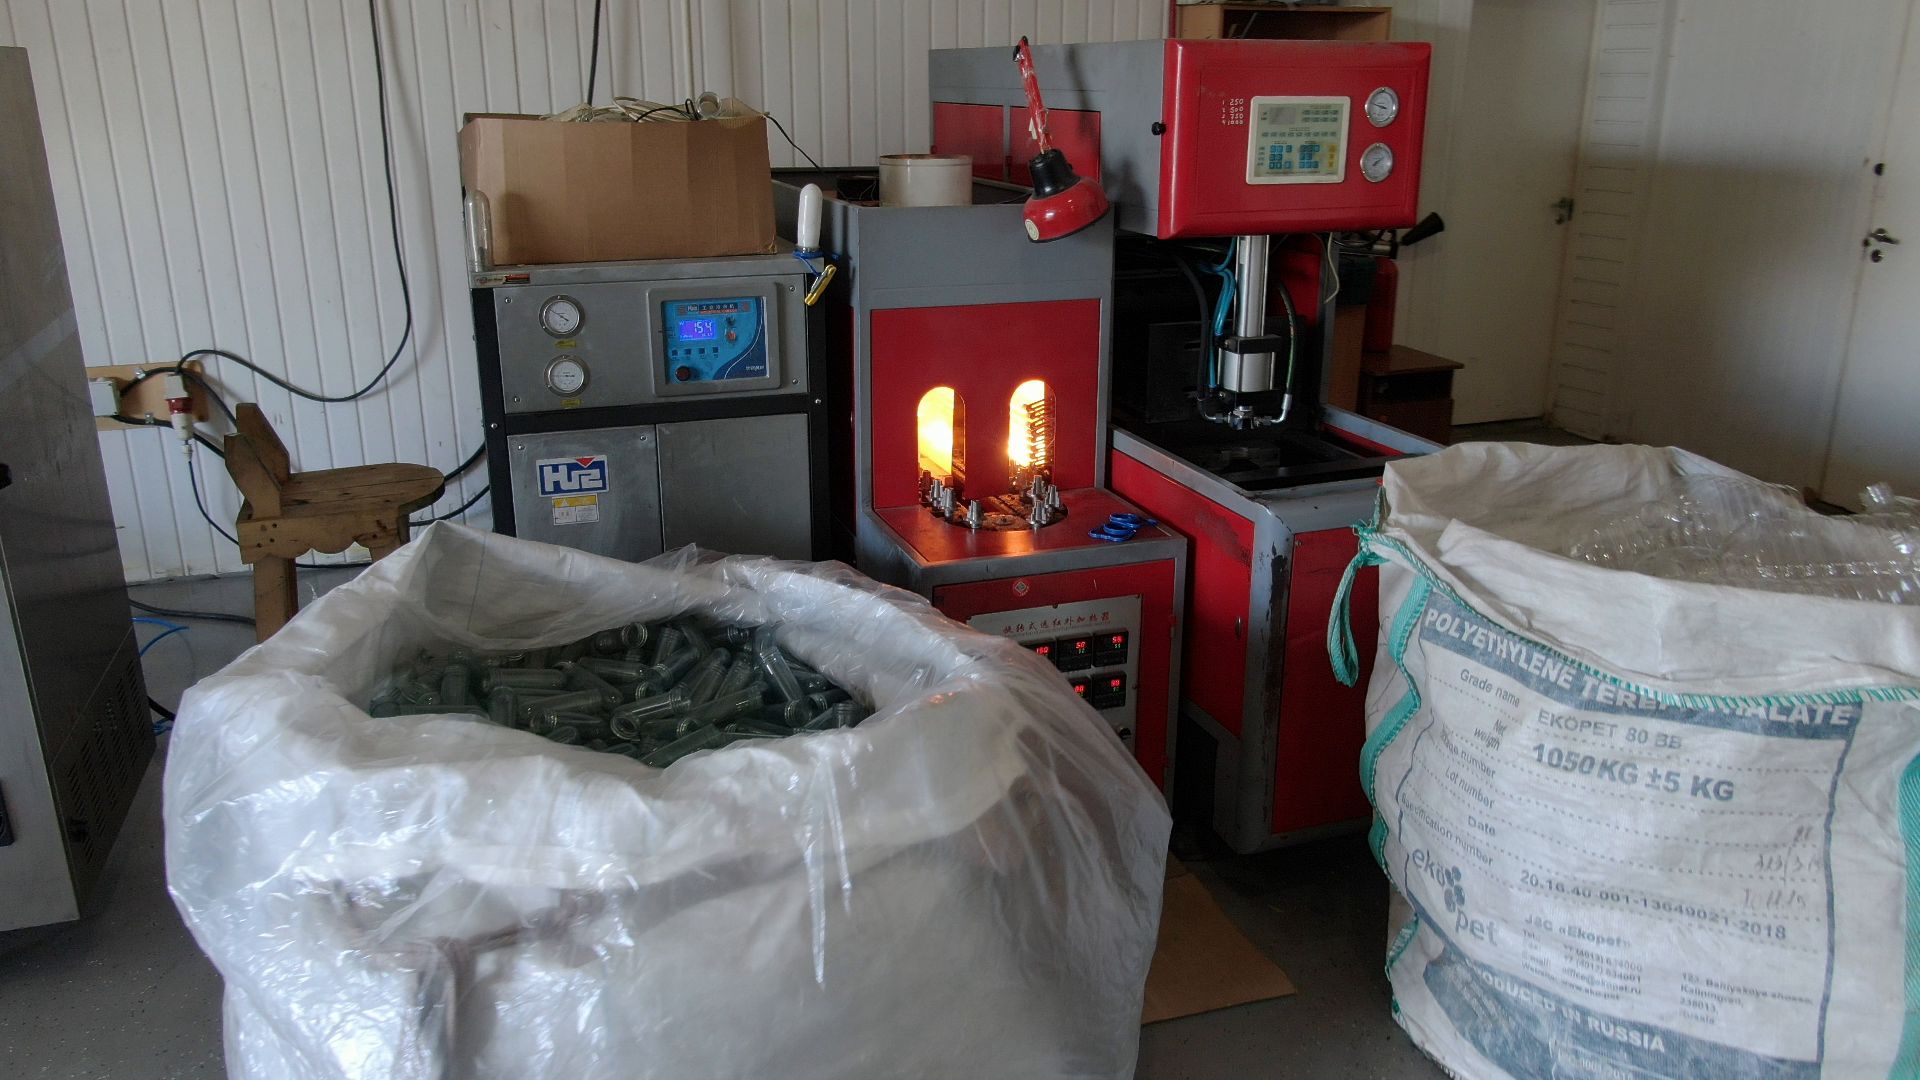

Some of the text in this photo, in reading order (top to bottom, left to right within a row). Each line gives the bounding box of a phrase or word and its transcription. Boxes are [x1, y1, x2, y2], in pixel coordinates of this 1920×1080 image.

[1229, 98, 1244, 106] 250
[1229, 106, 1244, 114] 500
[1425, 607, 1578, 690] POLYETHYLENE
[1460, 668, 1521, 708] Grade name
[1625, 726, 1649, 744] 80
[1461, 750, 1496, 779] number
[1445, 766, 1495, 808] Lot number
[1645, 766, 1681, 794] ±5
[1691, 774, 1735, 801] KG
[1468, 815, 1497, 836] Date
[1455, 835, 1494, 866] number
[1456, 908, 1498, 947] pet
[1466, 958, 1556, 1012] ODUCED
[1561, 1005, 1582, 1025] IN
[1587, 1014, 1666, 1053] RUSSIA
